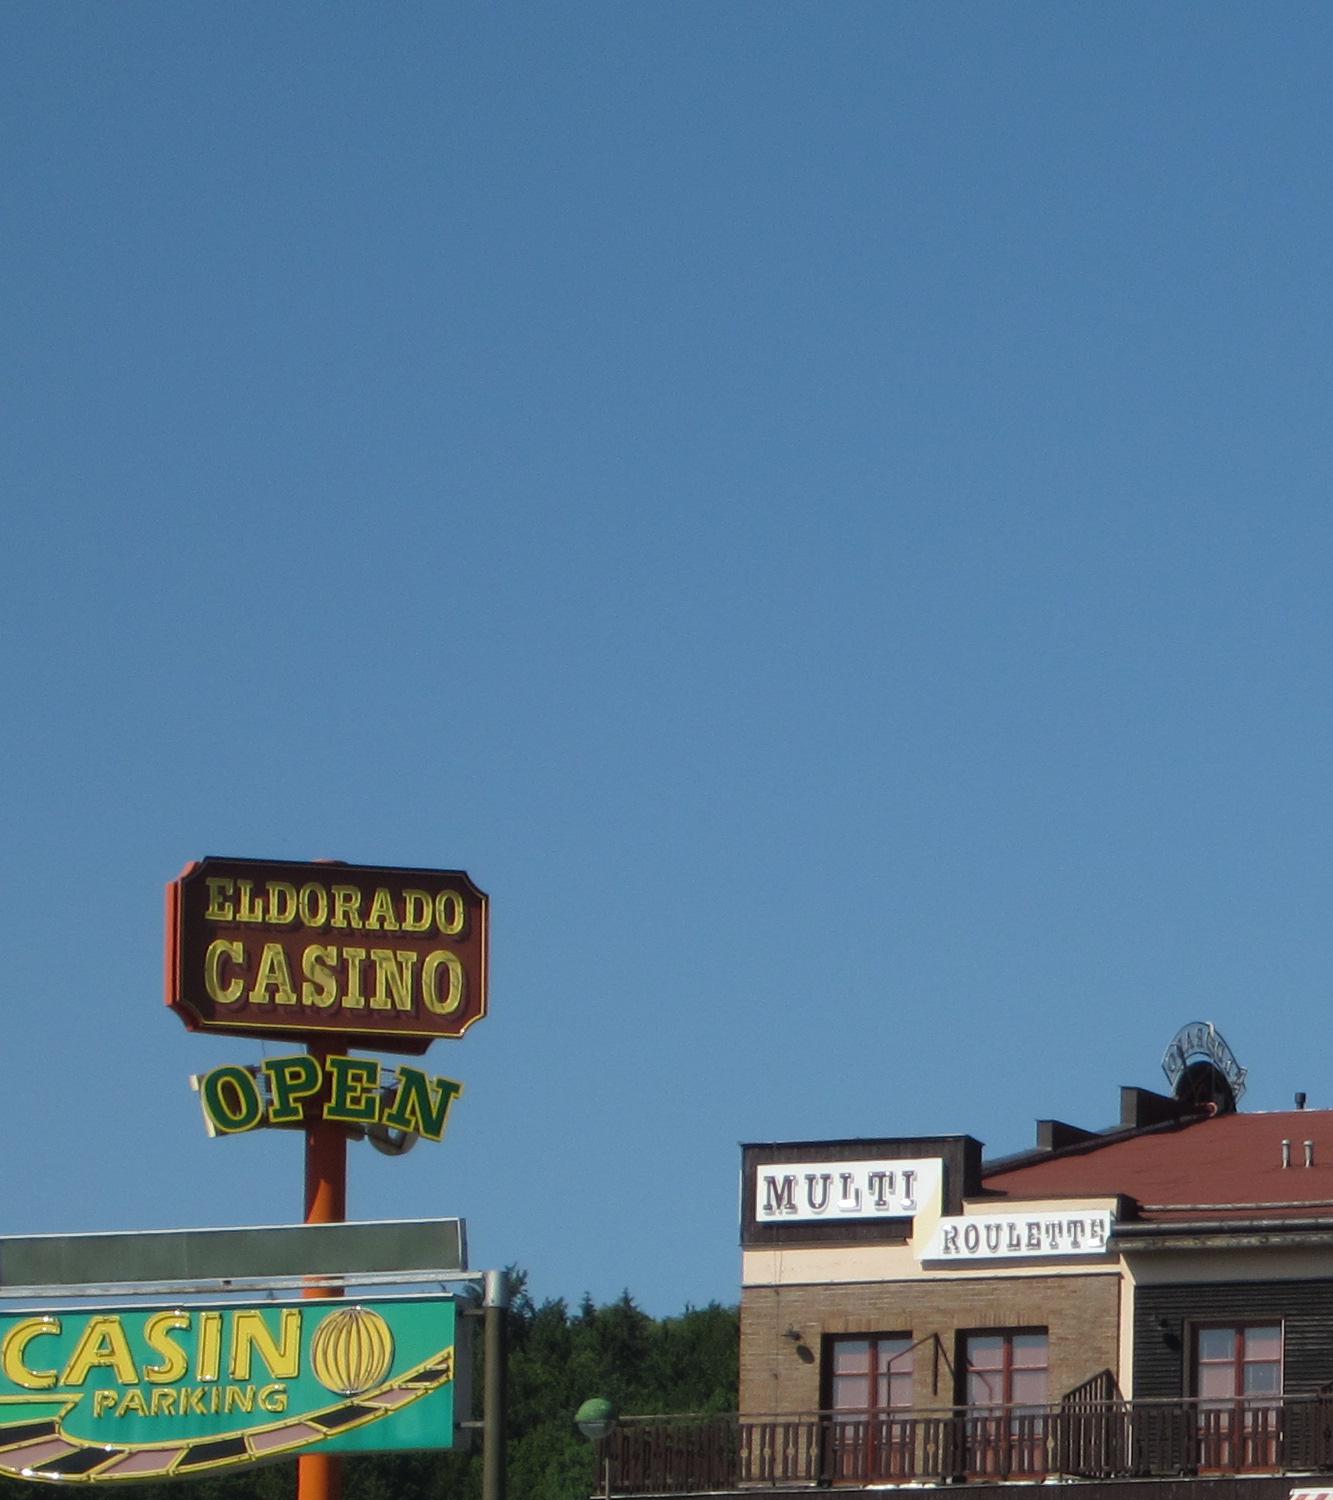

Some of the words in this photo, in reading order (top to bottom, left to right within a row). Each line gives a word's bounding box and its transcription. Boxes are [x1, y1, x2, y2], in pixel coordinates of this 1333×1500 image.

[205, 877, 465, 936] ELDORADO
[205, 941, 464, 1014] CASINO
[201, 1056, 463, 1142] OPEN
[762, 1170, 918, 1214] MULTI
[942, 1218, 1106, 1254] ROULETTE
[93, 1383, 289, 1417] PARKING
